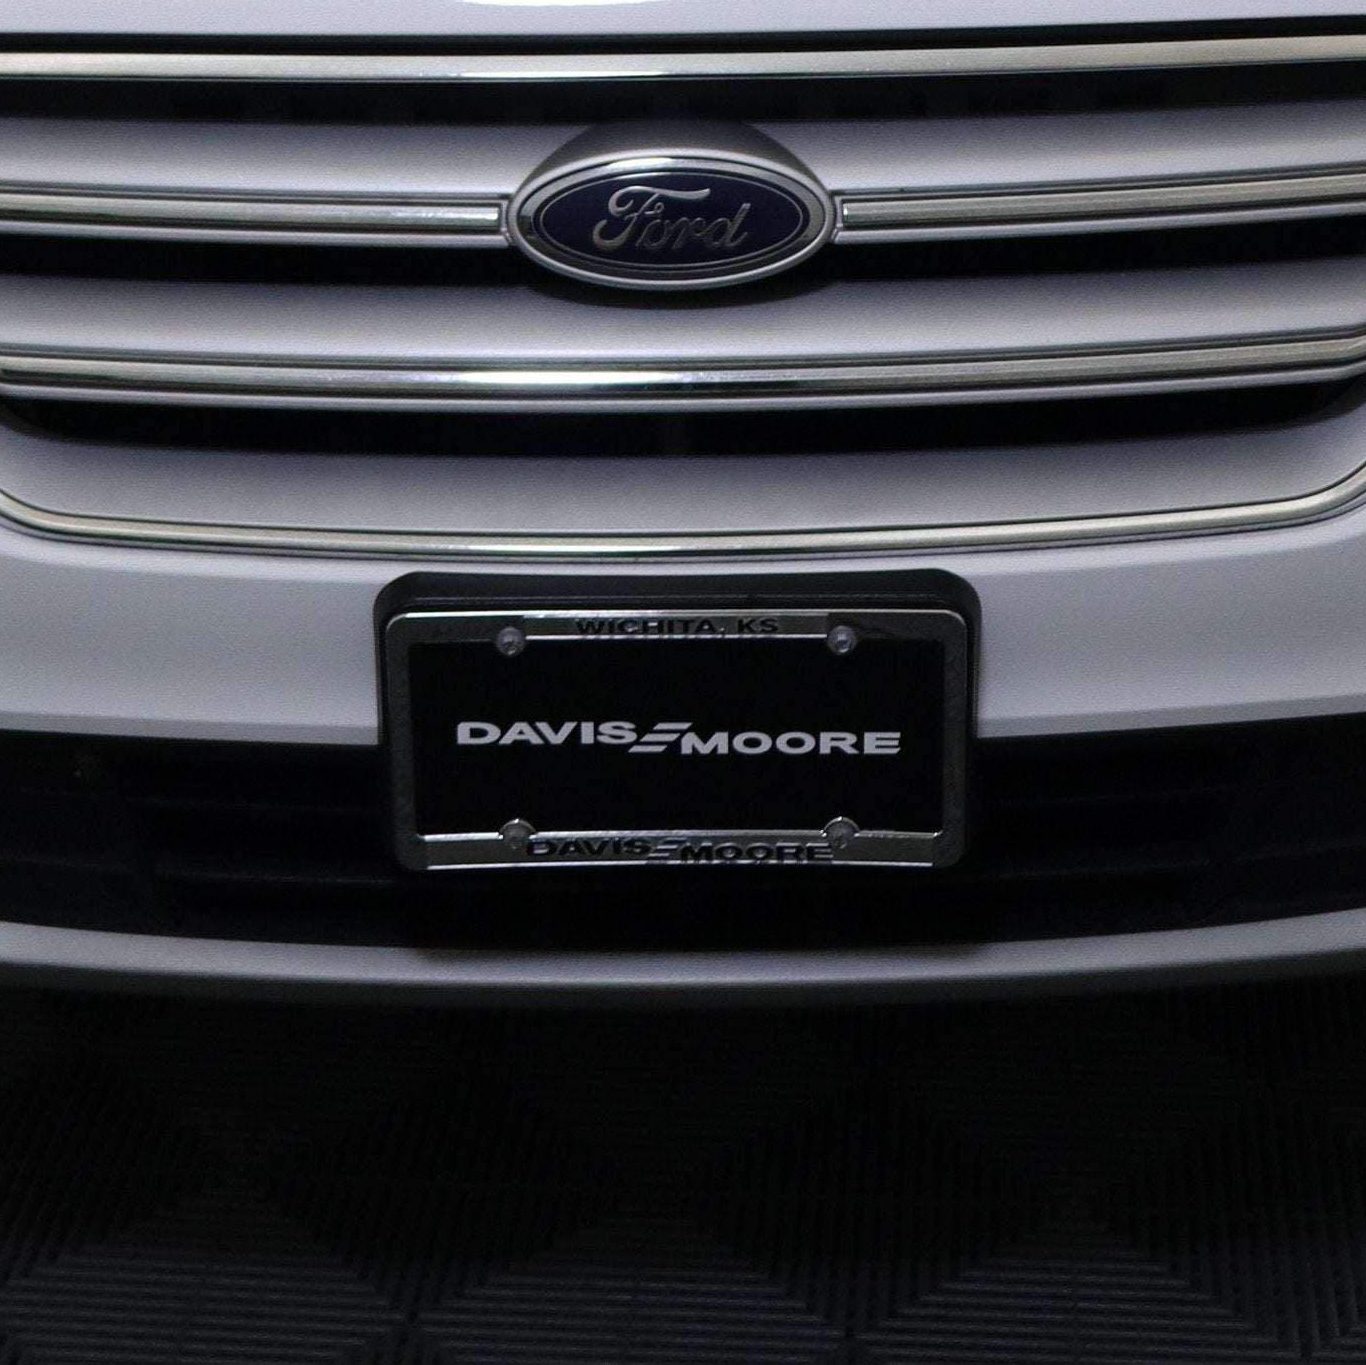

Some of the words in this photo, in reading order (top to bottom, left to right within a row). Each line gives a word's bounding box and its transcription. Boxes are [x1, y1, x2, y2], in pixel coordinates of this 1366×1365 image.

[592, 185, 751, 250] Ford
[575, 618, 726, 638] WICHITA,
[737, 617, 779, 634] KS
[456, 721, 635, 745] DAVIS
[680, 731, 901, 755] MOORE
[526, 837, 652, 856] DAVIS
[680, 842, 834, 862] MOORE
